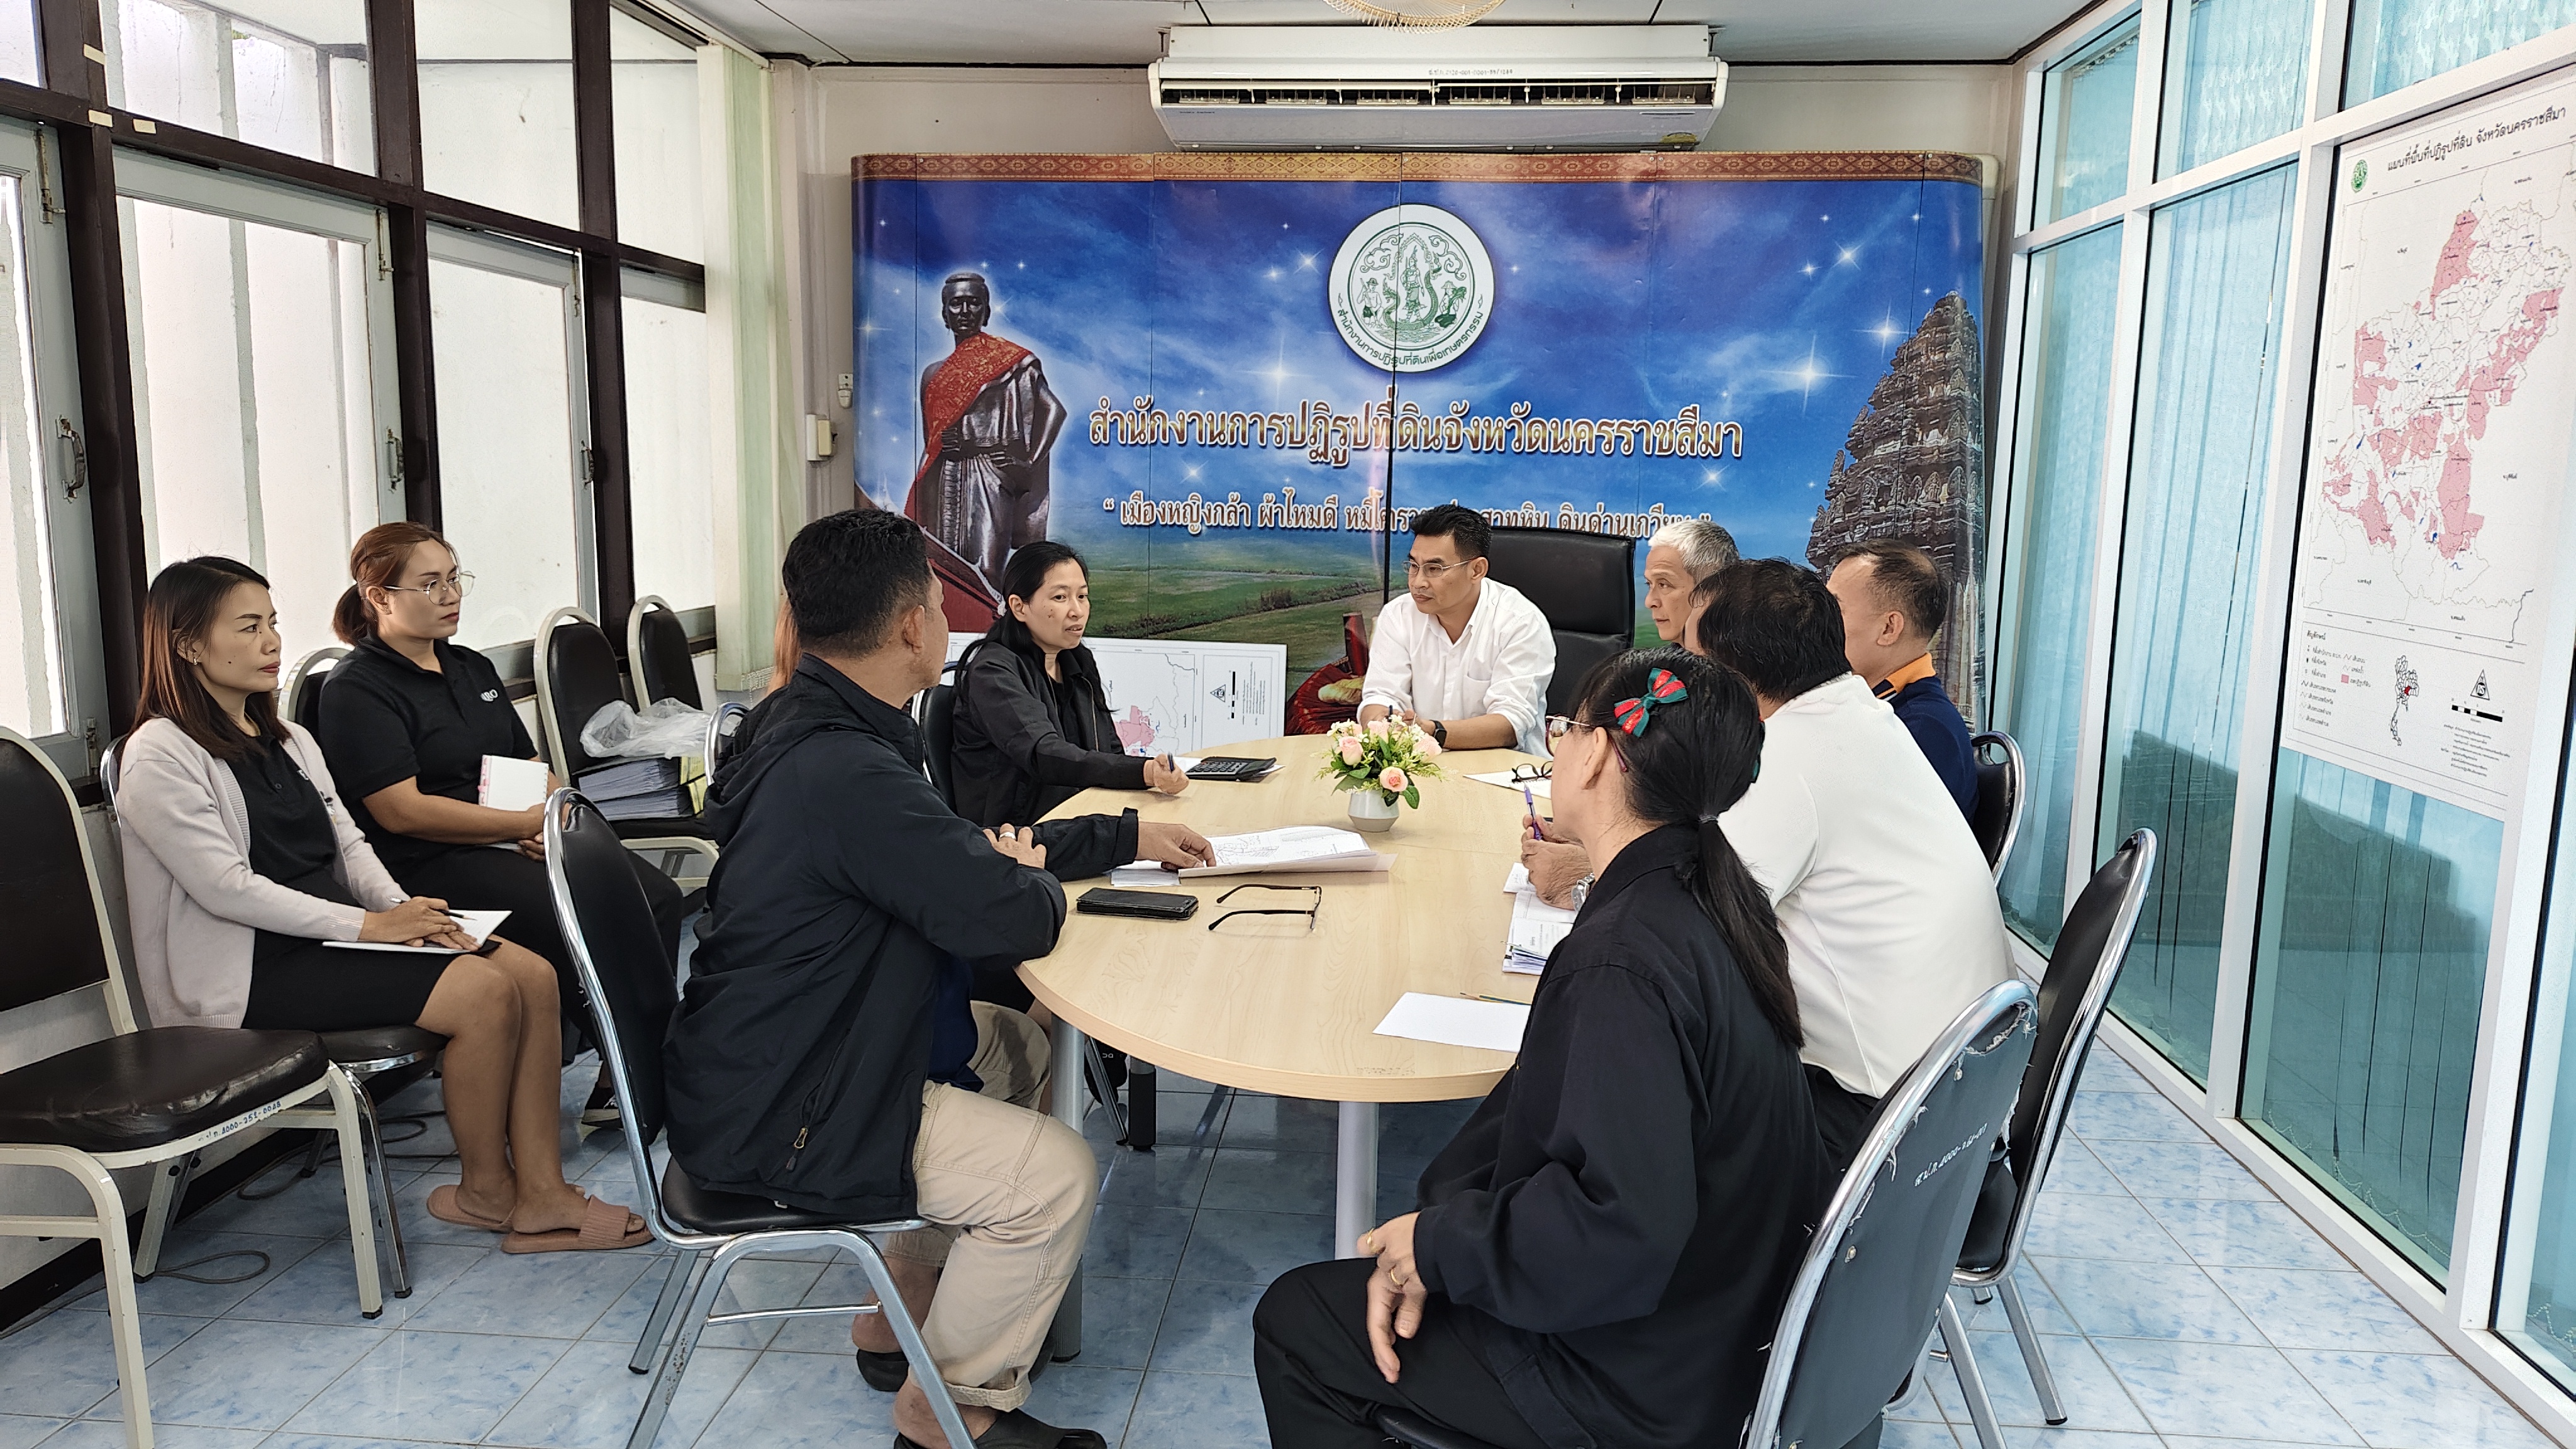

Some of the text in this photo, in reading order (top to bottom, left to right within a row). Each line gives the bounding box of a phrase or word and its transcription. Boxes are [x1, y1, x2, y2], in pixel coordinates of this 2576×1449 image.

[2387, 105, 2567, 171] แผนที่พื้นที่ปฏิรูปที่ดิน จังหวัดนครราชสีมา
[1089, 386, 1743, 467] สำนักงานการปฏิรูปที่ดินจังหวัดนครราชสีมา
[1121, 491, 1251, 534] เมืองหญิงกล้า
[1258, 487, 1339, 529] ผ้าไหมดี
